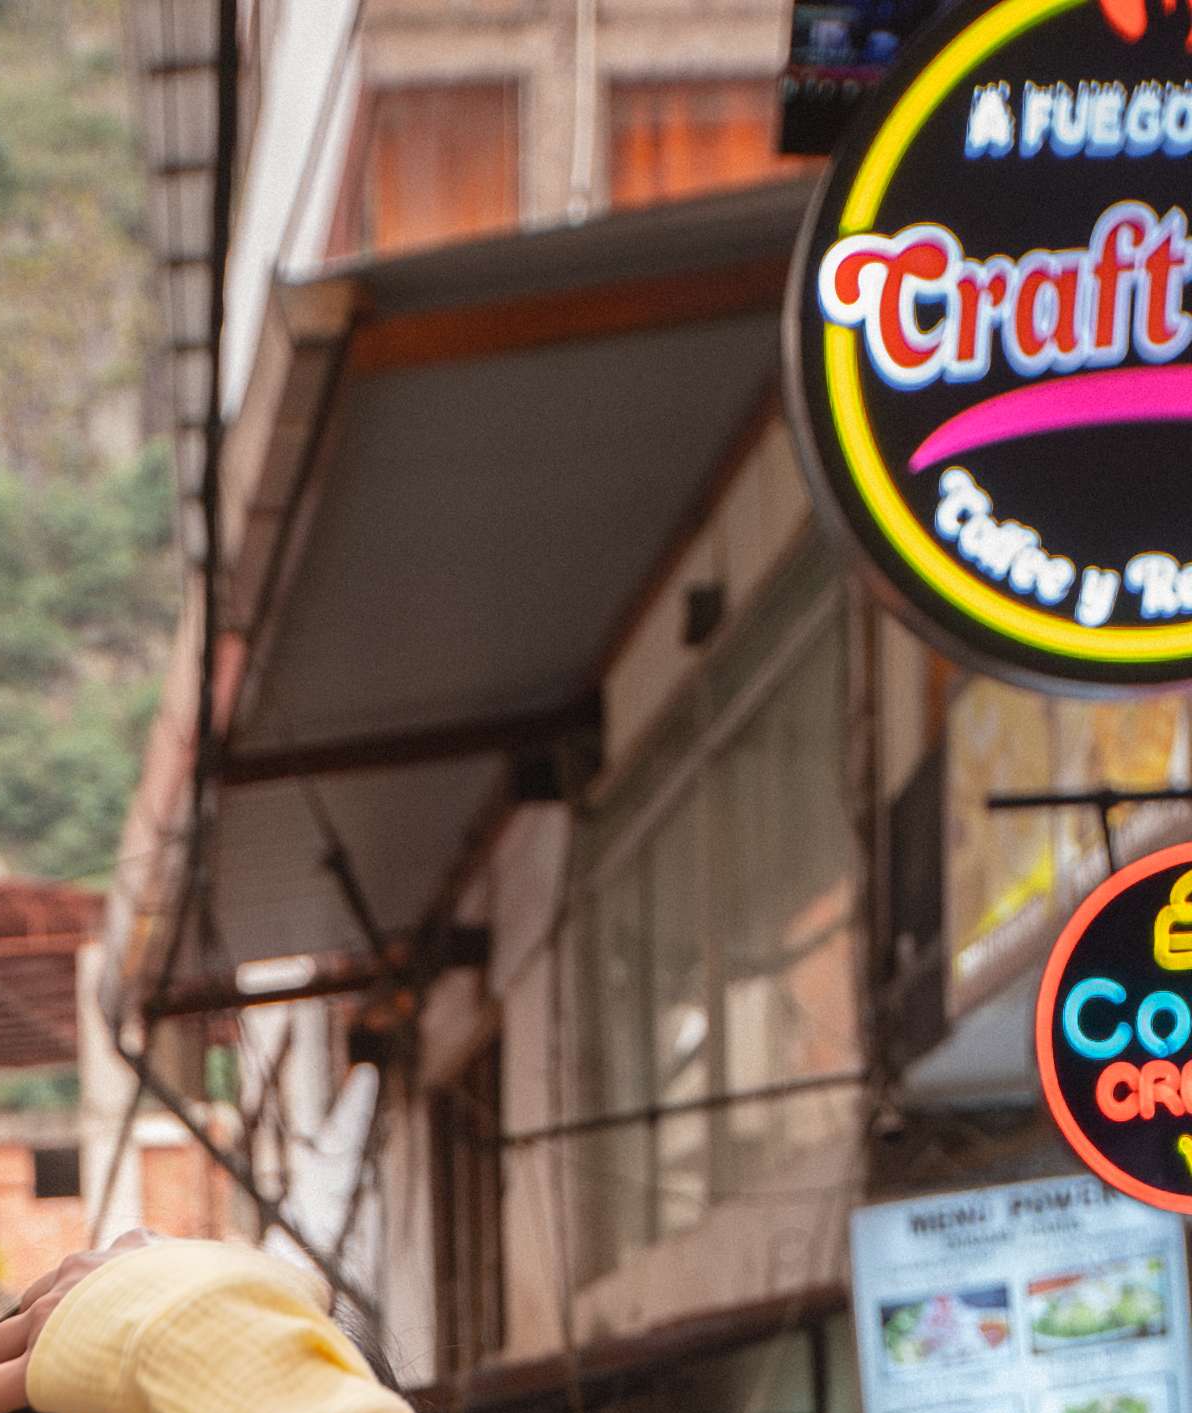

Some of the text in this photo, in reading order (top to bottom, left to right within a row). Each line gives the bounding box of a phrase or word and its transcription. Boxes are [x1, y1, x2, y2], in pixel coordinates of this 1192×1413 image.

[964, 79, 1192, 158] A FUEGO
[818, 199, 1192, 390] Craft
[1074, 564, 1122, 627] y
[1095, 1059, 1192, 1123] CR
